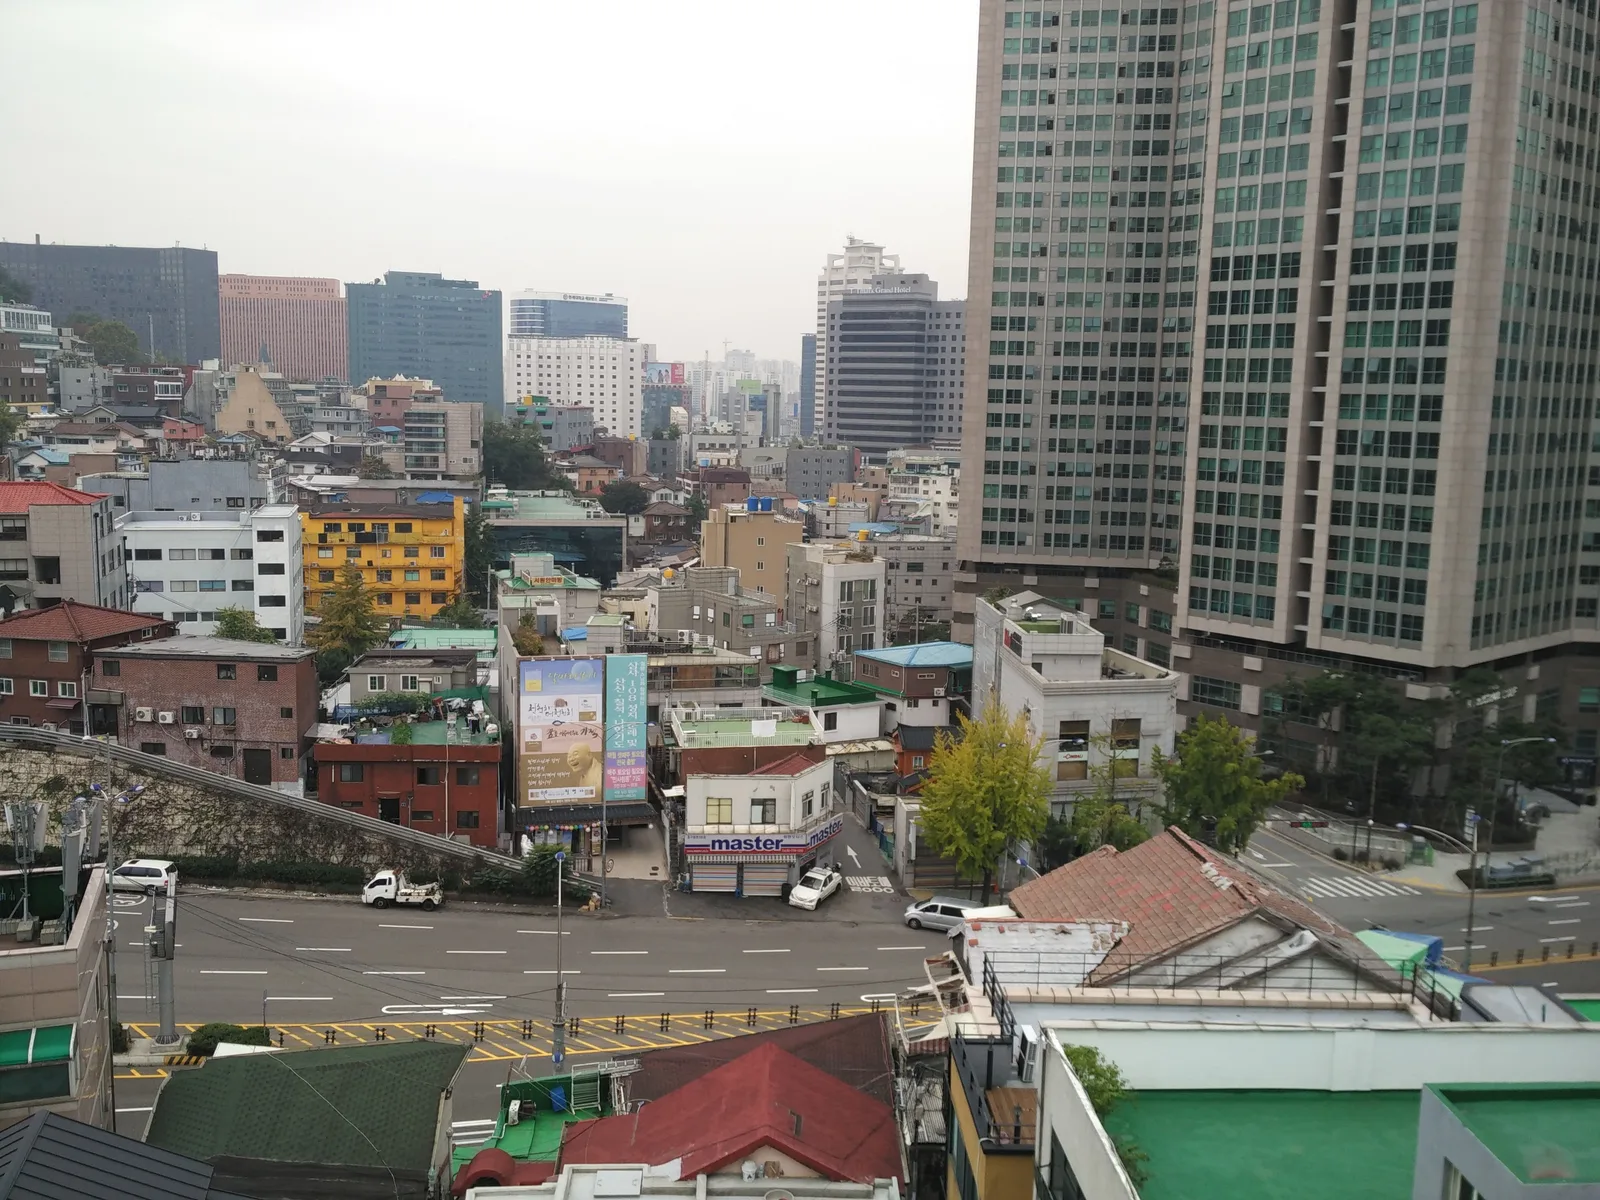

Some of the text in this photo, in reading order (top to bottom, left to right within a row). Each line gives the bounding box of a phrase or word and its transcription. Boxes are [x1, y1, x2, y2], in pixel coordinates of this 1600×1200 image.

[628, 679, 637, 701] 108
[711, 836, 784, 850] master
[810, 819, 841, 847] master
